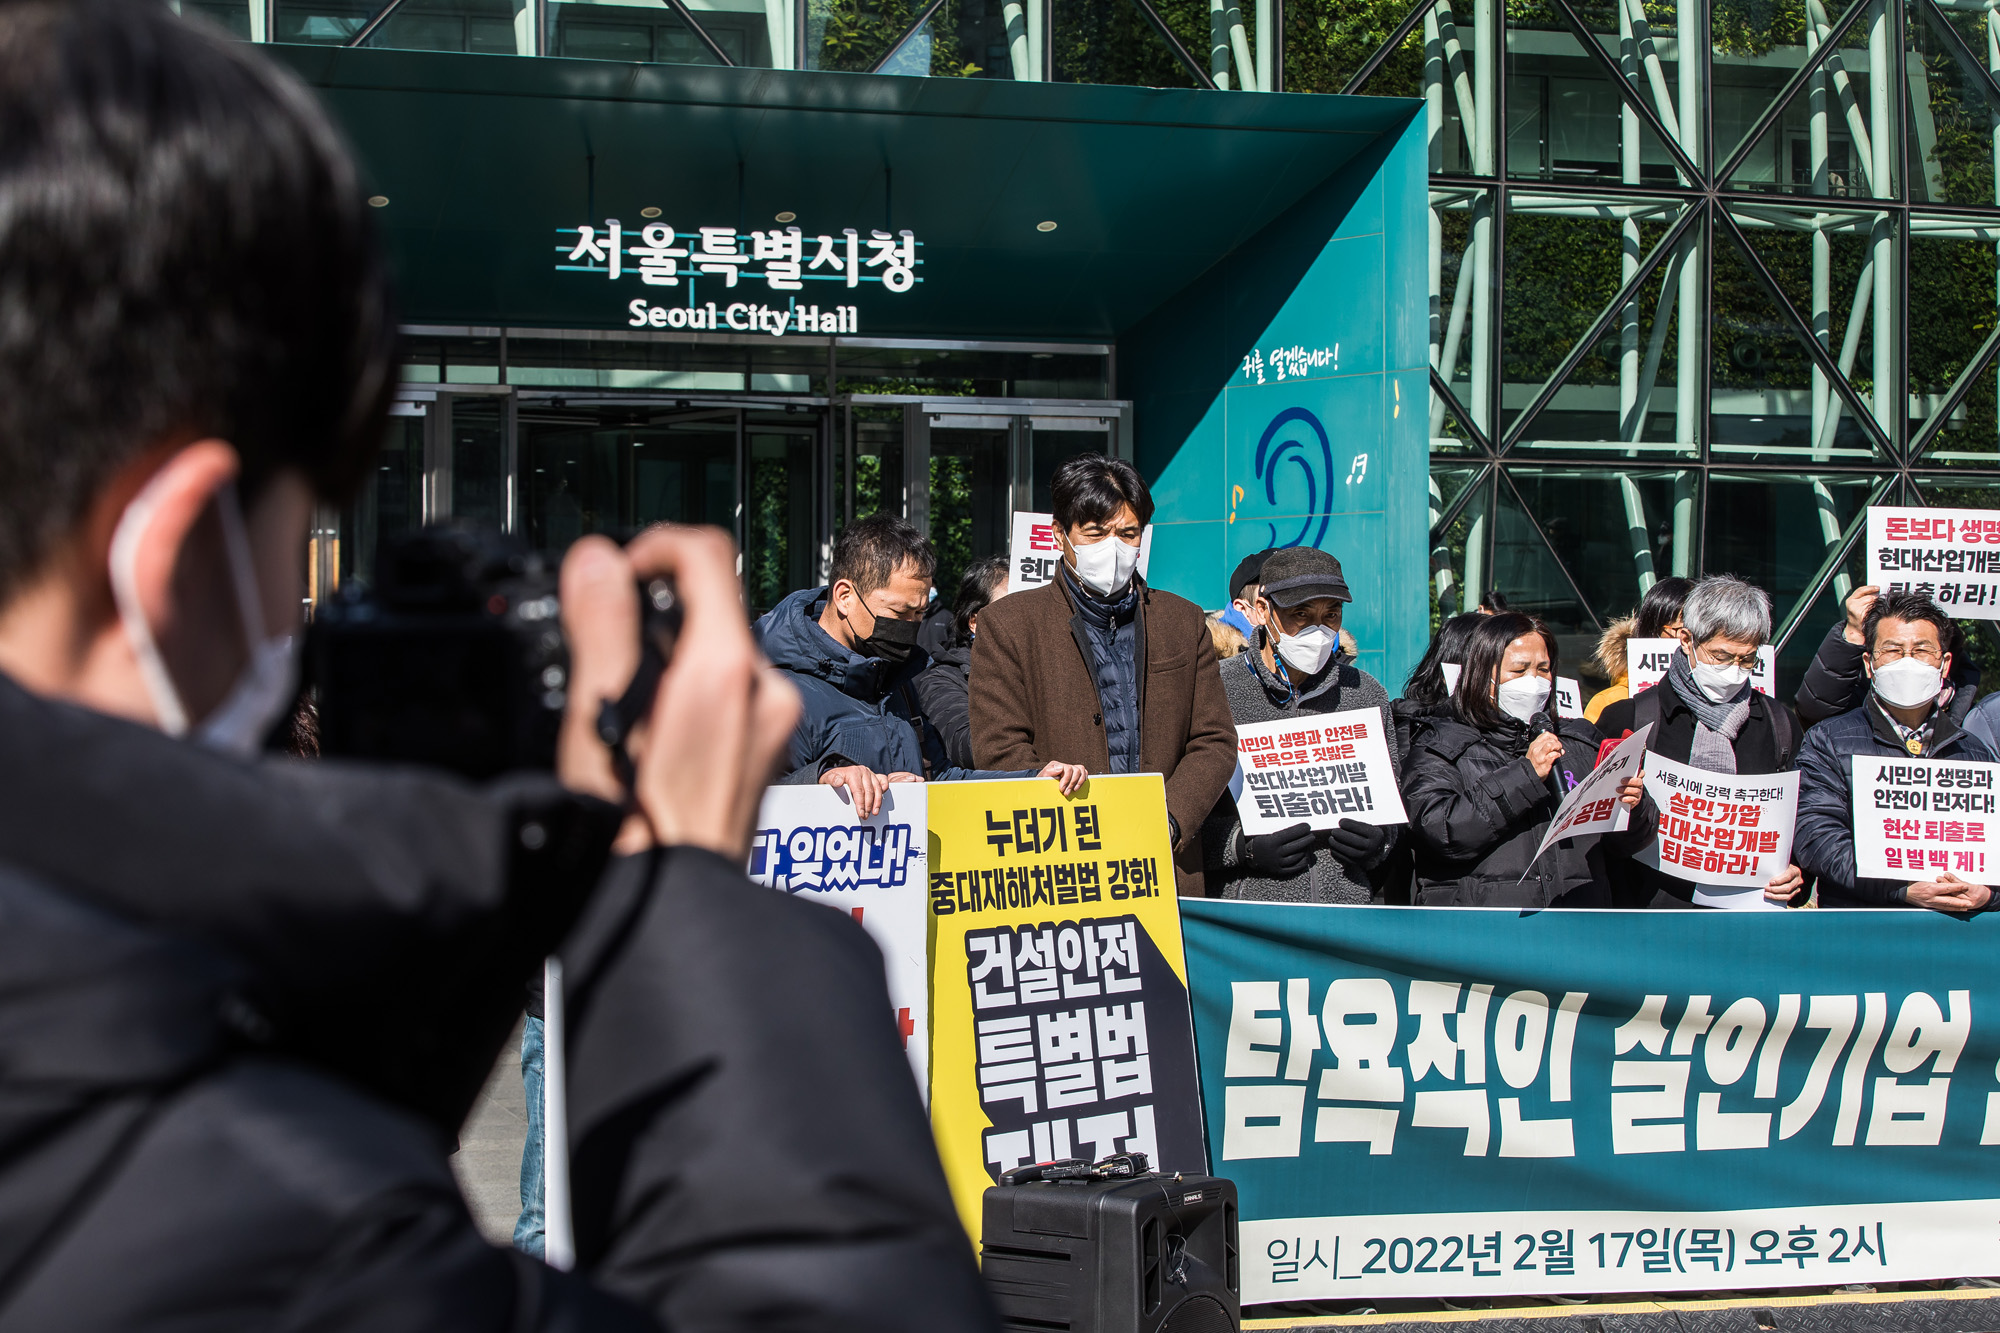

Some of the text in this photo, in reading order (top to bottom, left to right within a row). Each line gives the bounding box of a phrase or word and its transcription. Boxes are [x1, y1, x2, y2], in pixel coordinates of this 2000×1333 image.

[568, 218, 915, 293] 서울특별시청
[628, 299, 858, 336] Seoul City Hall
[1242, 342, 1339, 385] 귀를 열겠습니다!
[1885, 517, 1955, 542] 돈보다
[1237, 723, 1368, 753] 시민의 생명과 안전을
[1251, 743, 1356, 768] 탐욕으로 짓밟은
[1245, 761, 1368, 791] 현대산업개발
[1656, 770, 1784, 802] 서울시에 강력 촉구한다!
[1875, 765, 1993, 790] 시민의 생명과
[1254, 785, 1374, 818] 퇴출하라!
[1670, 792, 1761, 827] 살인기업
[1873, 789, 1995, 814] 안전이 먼저다!
[985, 804, 1102, 857] 누더기 된
[1882, 818, 1986, 842] 현산 퇴출로
[787, 826, 909, 891] 잊었나!
[1660, 838, 1760, 876] 퇴출하라!
[930, 857, 1160, 916] 중대재해처벌법 강화!
[969, 921, 1142, 1010] 건설안전
[978, 1001, 1153, 1114] 특별법
[1222, 978, 1589, 1161] 탐욕적인
[1610, 990, 1971, 1156] 살인기업
[1513, 1228, 1576, 1276] 2월
[1588, 1224, 1737, 1274] 17일(목)
[1745, 1224, 1820, 1269] 오후
[1829, 1221, 1887, 1266] 2시
